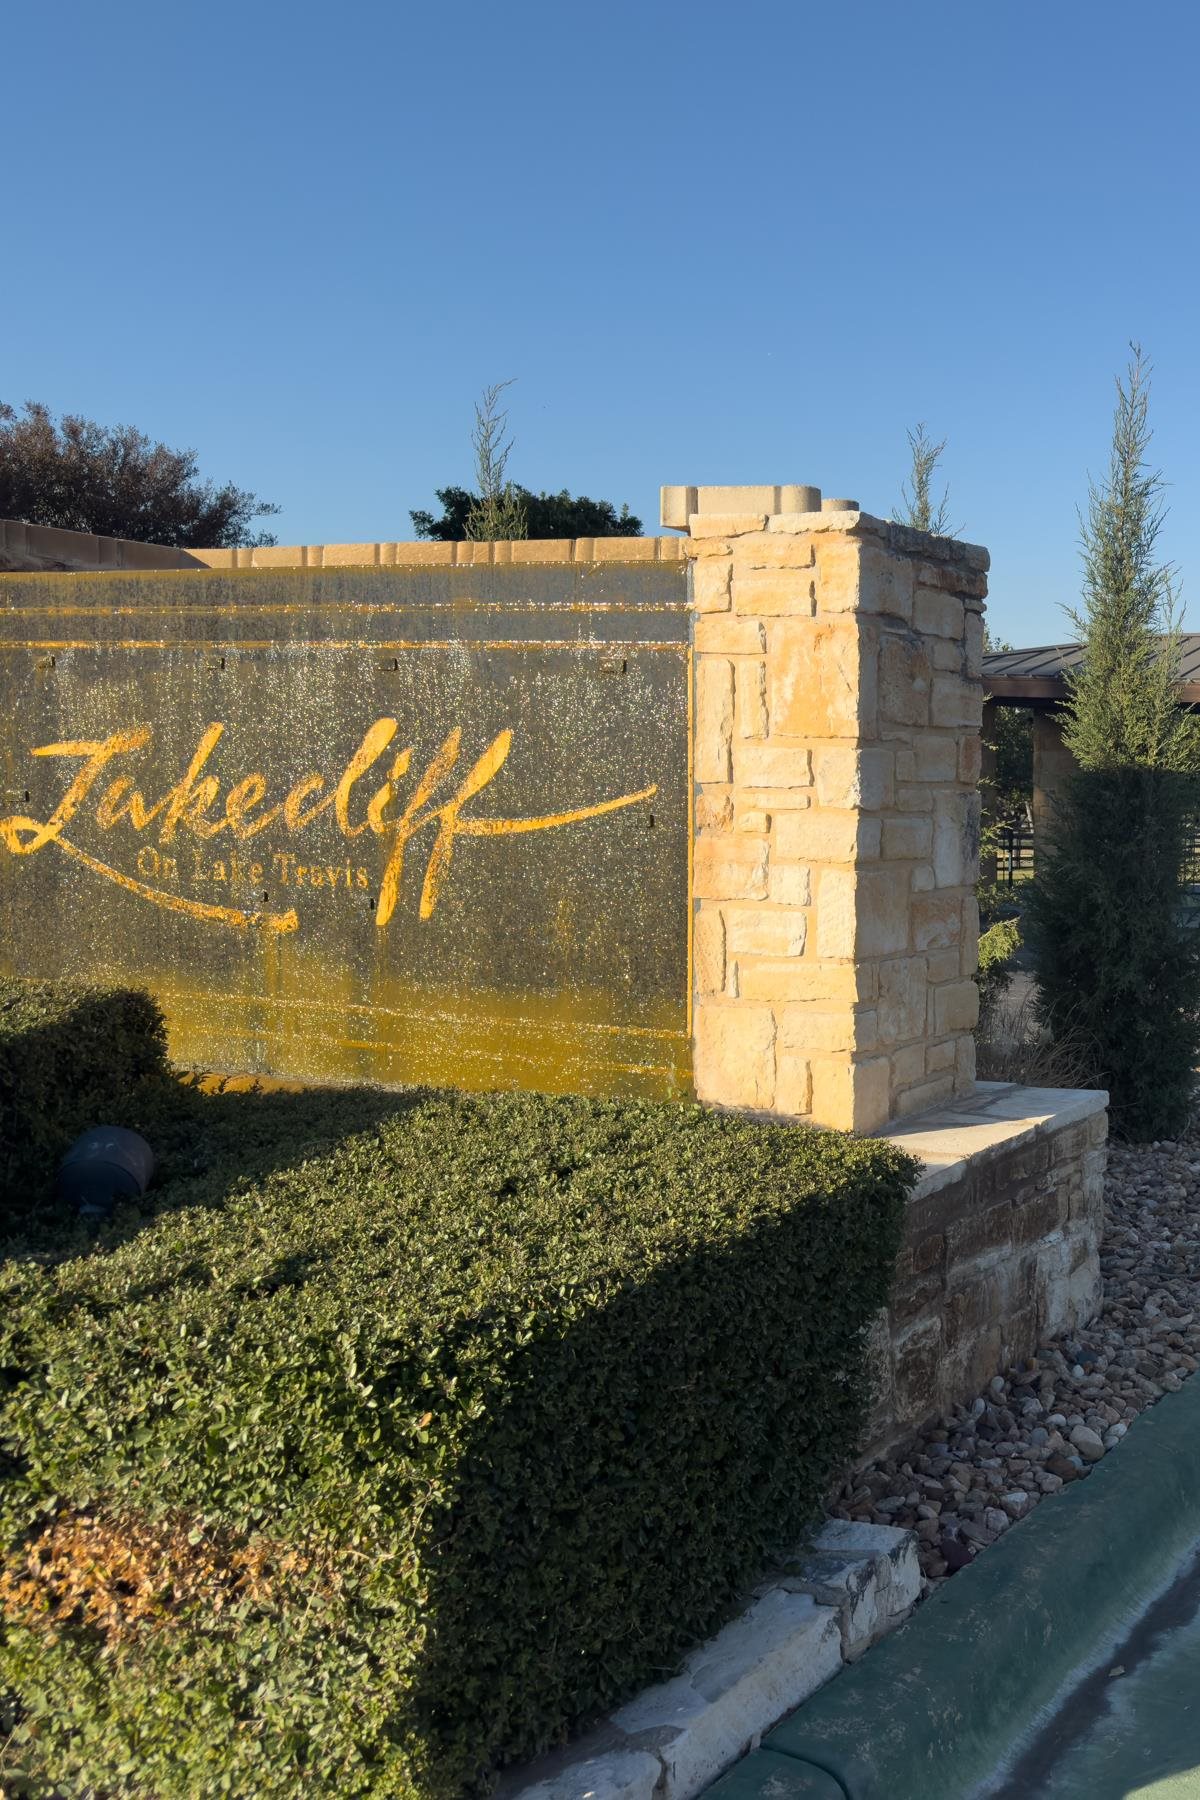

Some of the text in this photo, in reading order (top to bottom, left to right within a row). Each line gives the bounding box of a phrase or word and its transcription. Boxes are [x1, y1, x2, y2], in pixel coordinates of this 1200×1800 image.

[137, 846, 369, 890] On Lake Travis
